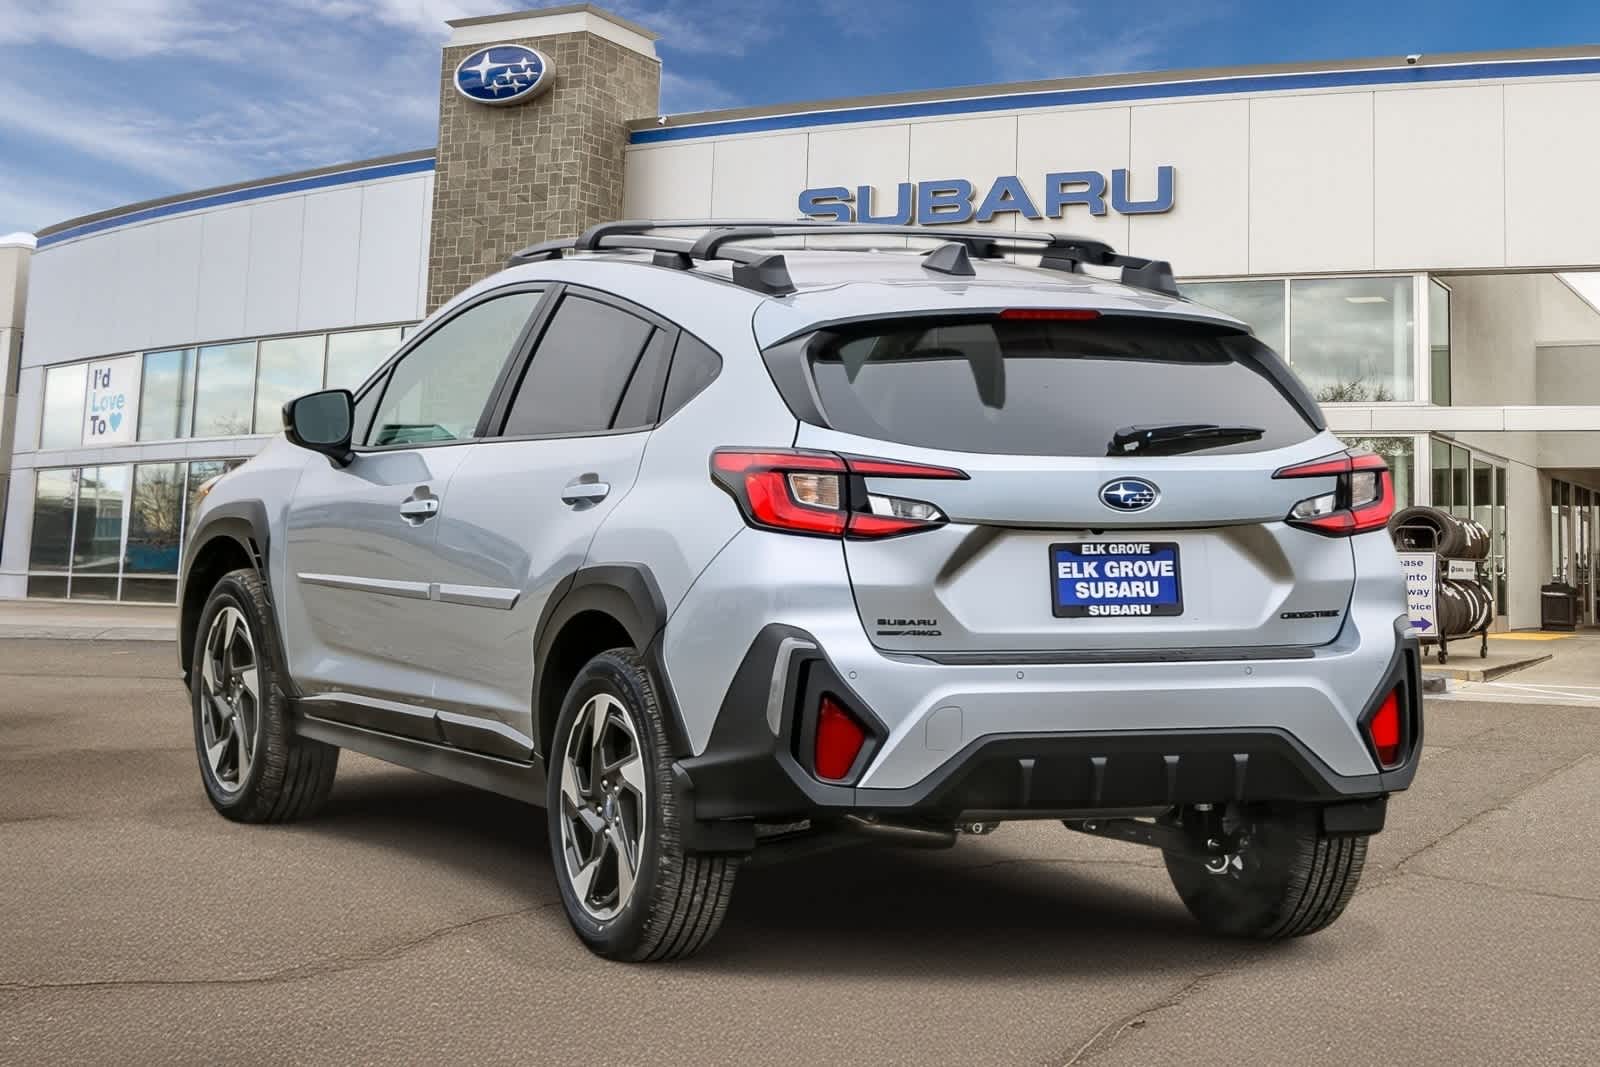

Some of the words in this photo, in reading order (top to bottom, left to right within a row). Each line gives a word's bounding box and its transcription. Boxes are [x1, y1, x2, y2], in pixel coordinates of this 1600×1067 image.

[797, 165, 1175, 225] SUBARU
[94, 368, 111, 389] I'd
[91, 392, 125, 412] Love
[91, 415, 106, 435] To
[1081, 544, 1107, 555] ELK
[1108, 543, 1151, 554] GROVE
[1058, 561, 1099, 579] ELK
[1104, 560, 1174, 578] GROVE
[1075, 581, 1160, 599] SUBARU
[1088, 604, 1152, 616] SUBARU
[877, 618, 937, 626] SUBARU
